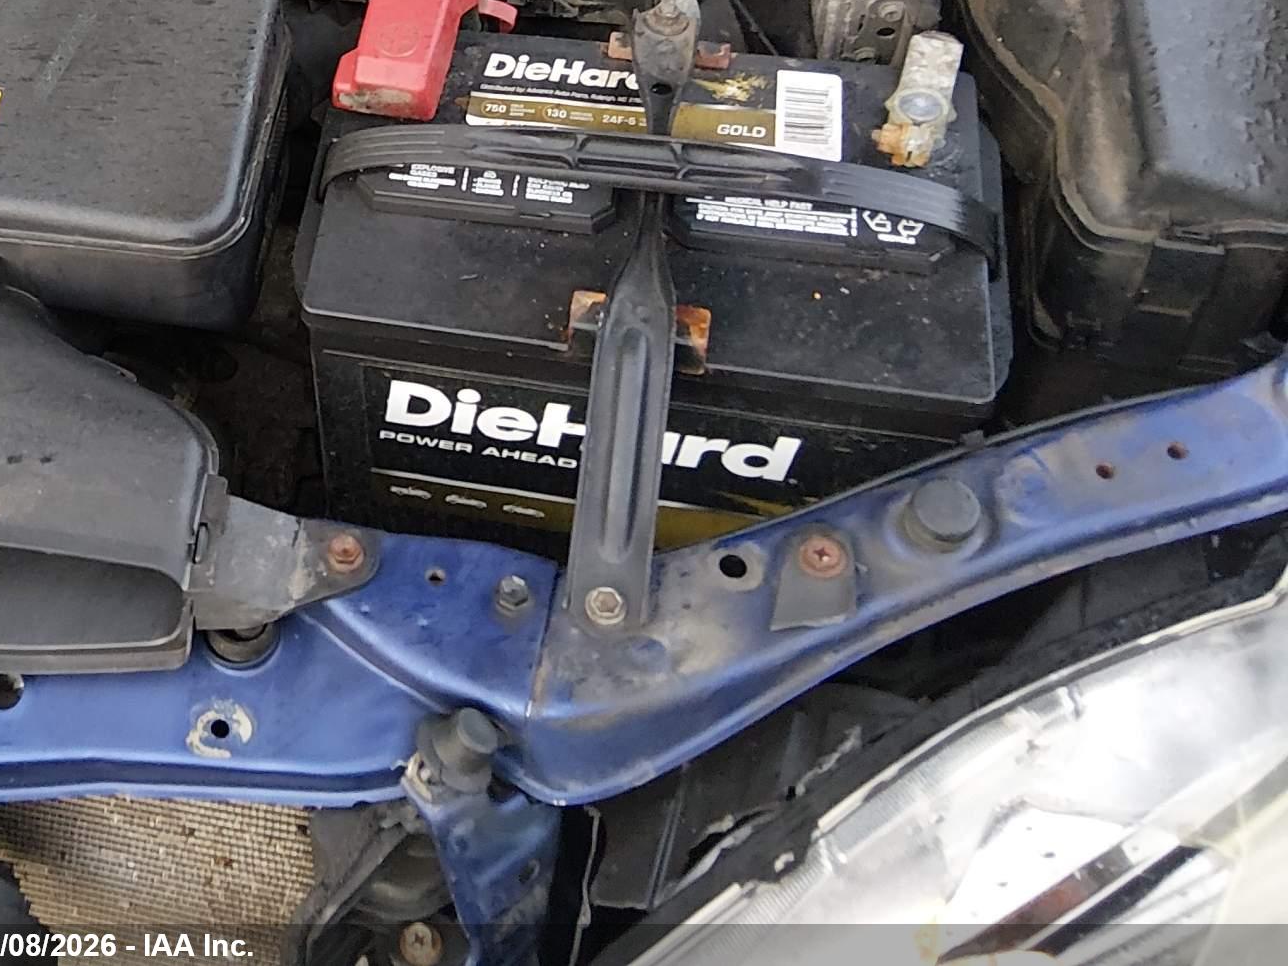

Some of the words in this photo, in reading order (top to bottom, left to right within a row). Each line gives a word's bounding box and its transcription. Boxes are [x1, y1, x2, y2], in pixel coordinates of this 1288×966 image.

[485, 103, 507, 114] 750
[546, 107, 567, 119] 130
[716, 124, 767, 139] GOLD
[379, 429, 473, 454] POWER
[481, 445, 578, 469] AHEAD
